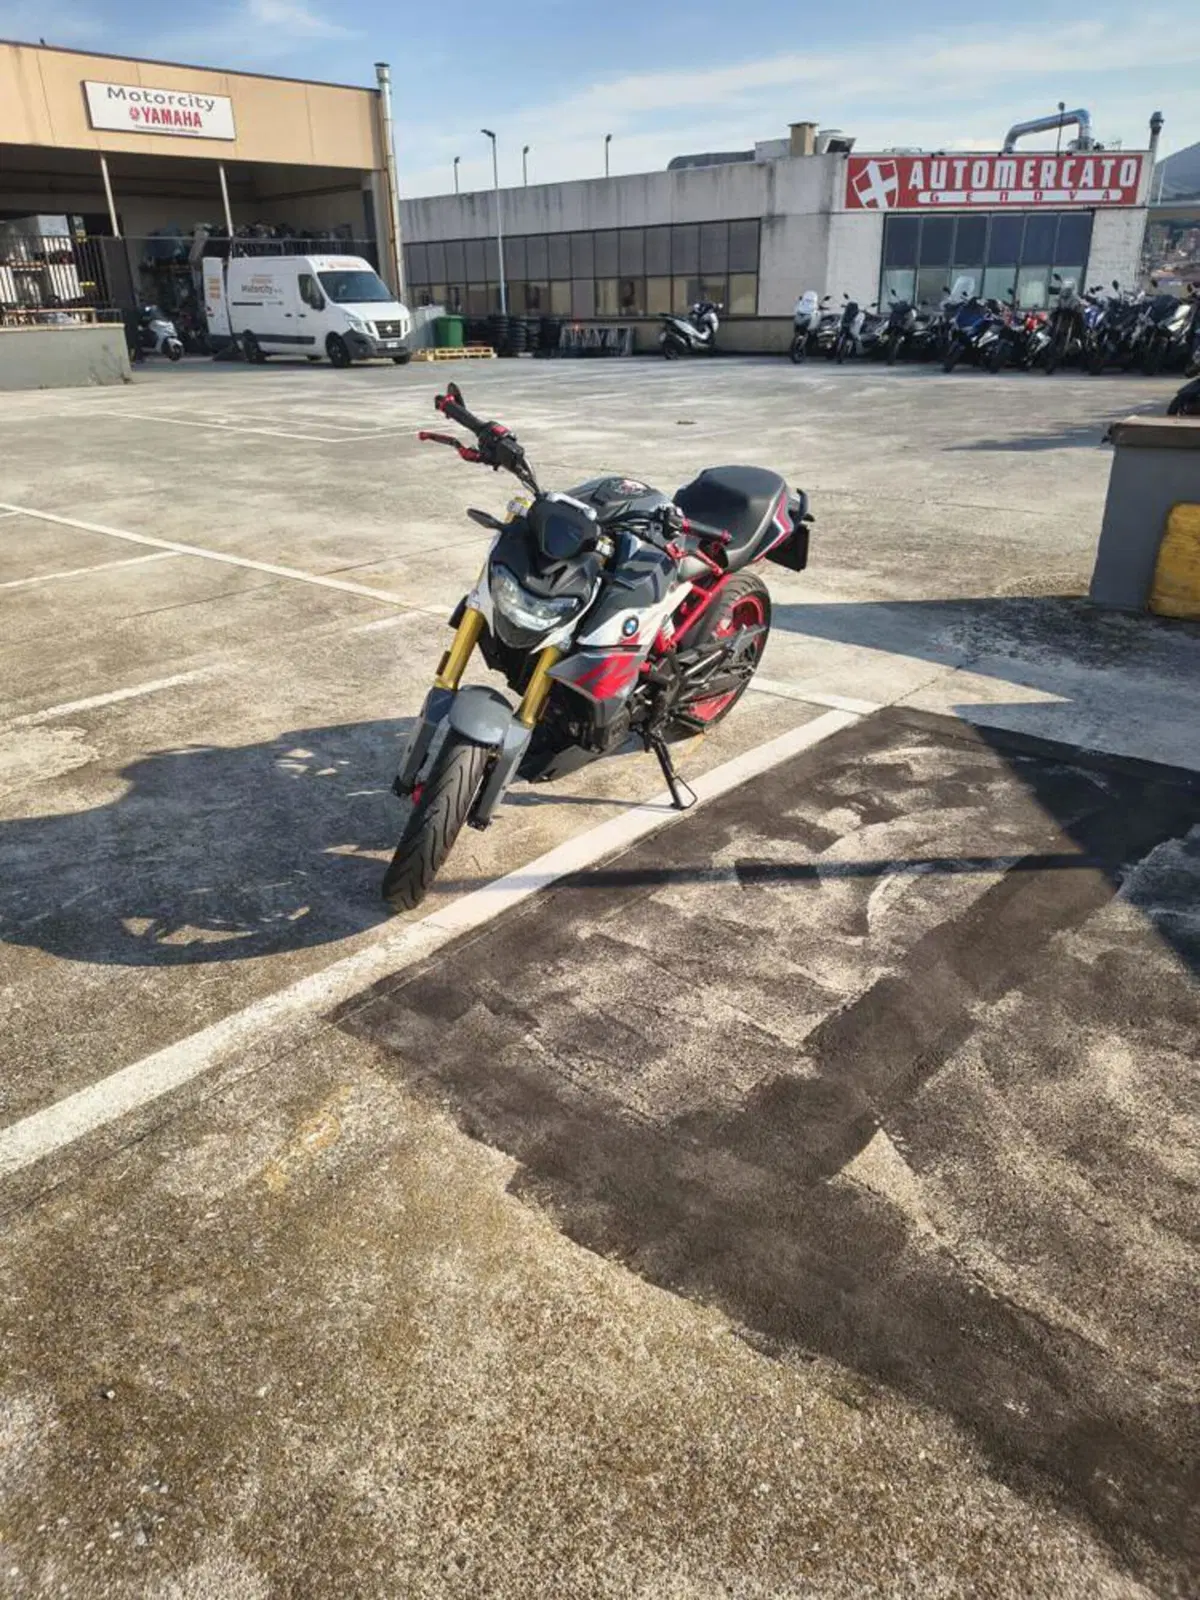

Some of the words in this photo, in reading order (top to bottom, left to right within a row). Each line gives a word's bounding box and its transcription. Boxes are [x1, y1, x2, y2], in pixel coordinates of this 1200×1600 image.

[107, 86, 215, 112] Motorcity
[141, 106, 203, 129] YAMAHA
[909, 159, 1137, 190] AUTOMERCATO
[930, 190, 1111, 202] GENOVA
